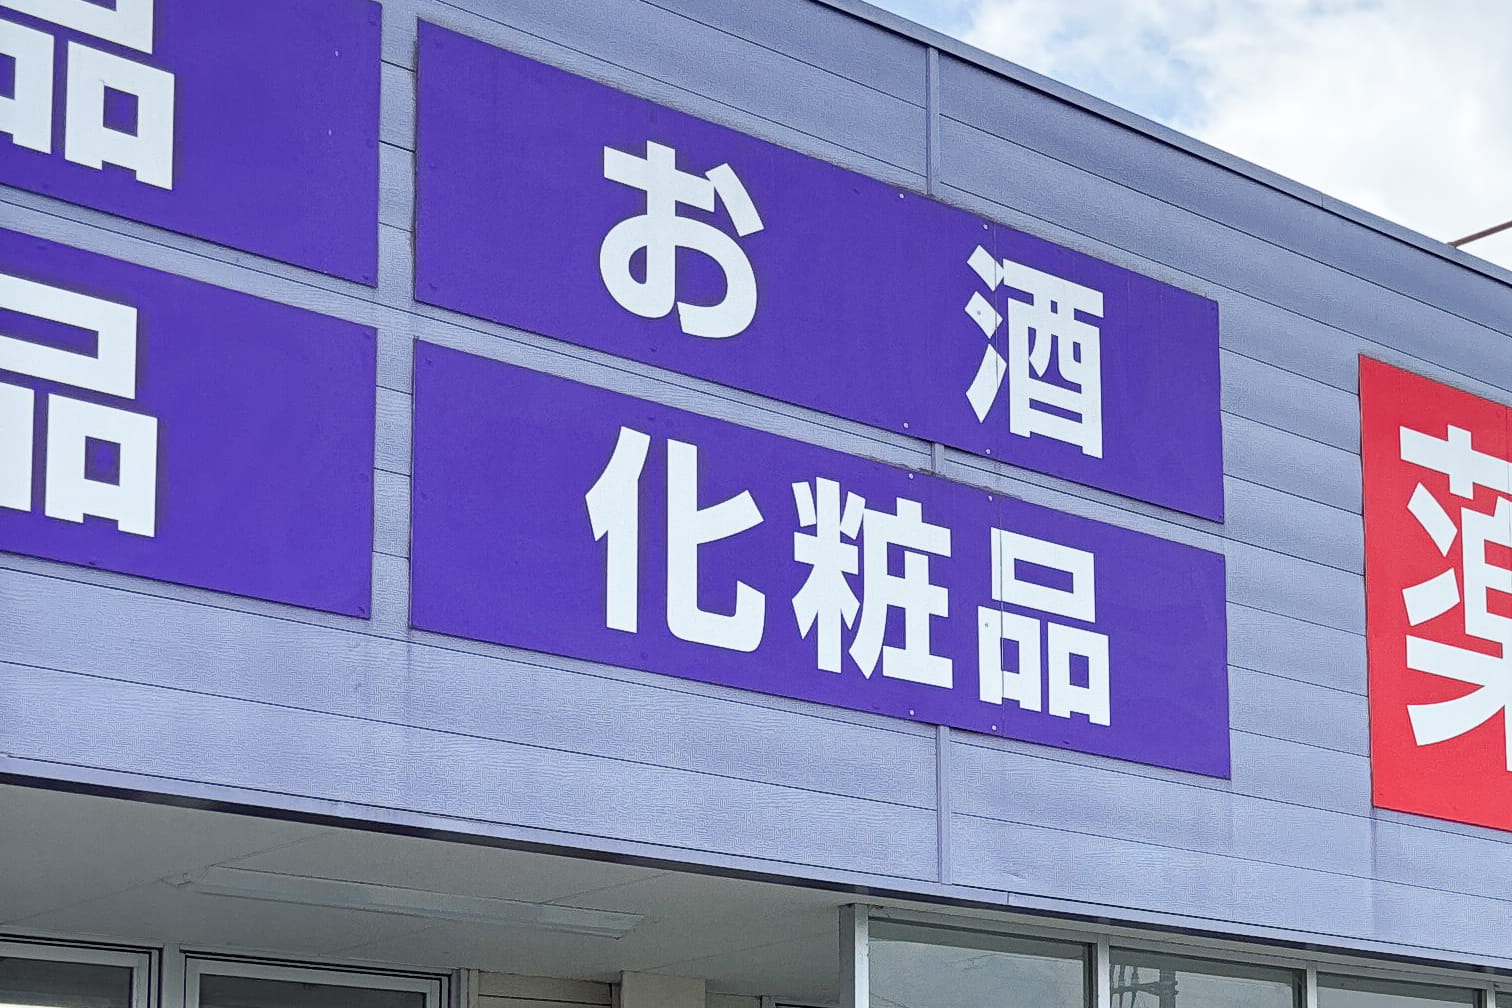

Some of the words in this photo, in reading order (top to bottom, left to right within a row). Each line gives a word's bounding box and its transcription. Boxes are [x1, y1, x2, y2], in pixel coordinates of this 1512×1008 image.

[599, 139, 1105, 460] お酒
[584, 425, 1112, 727] 化粧品
